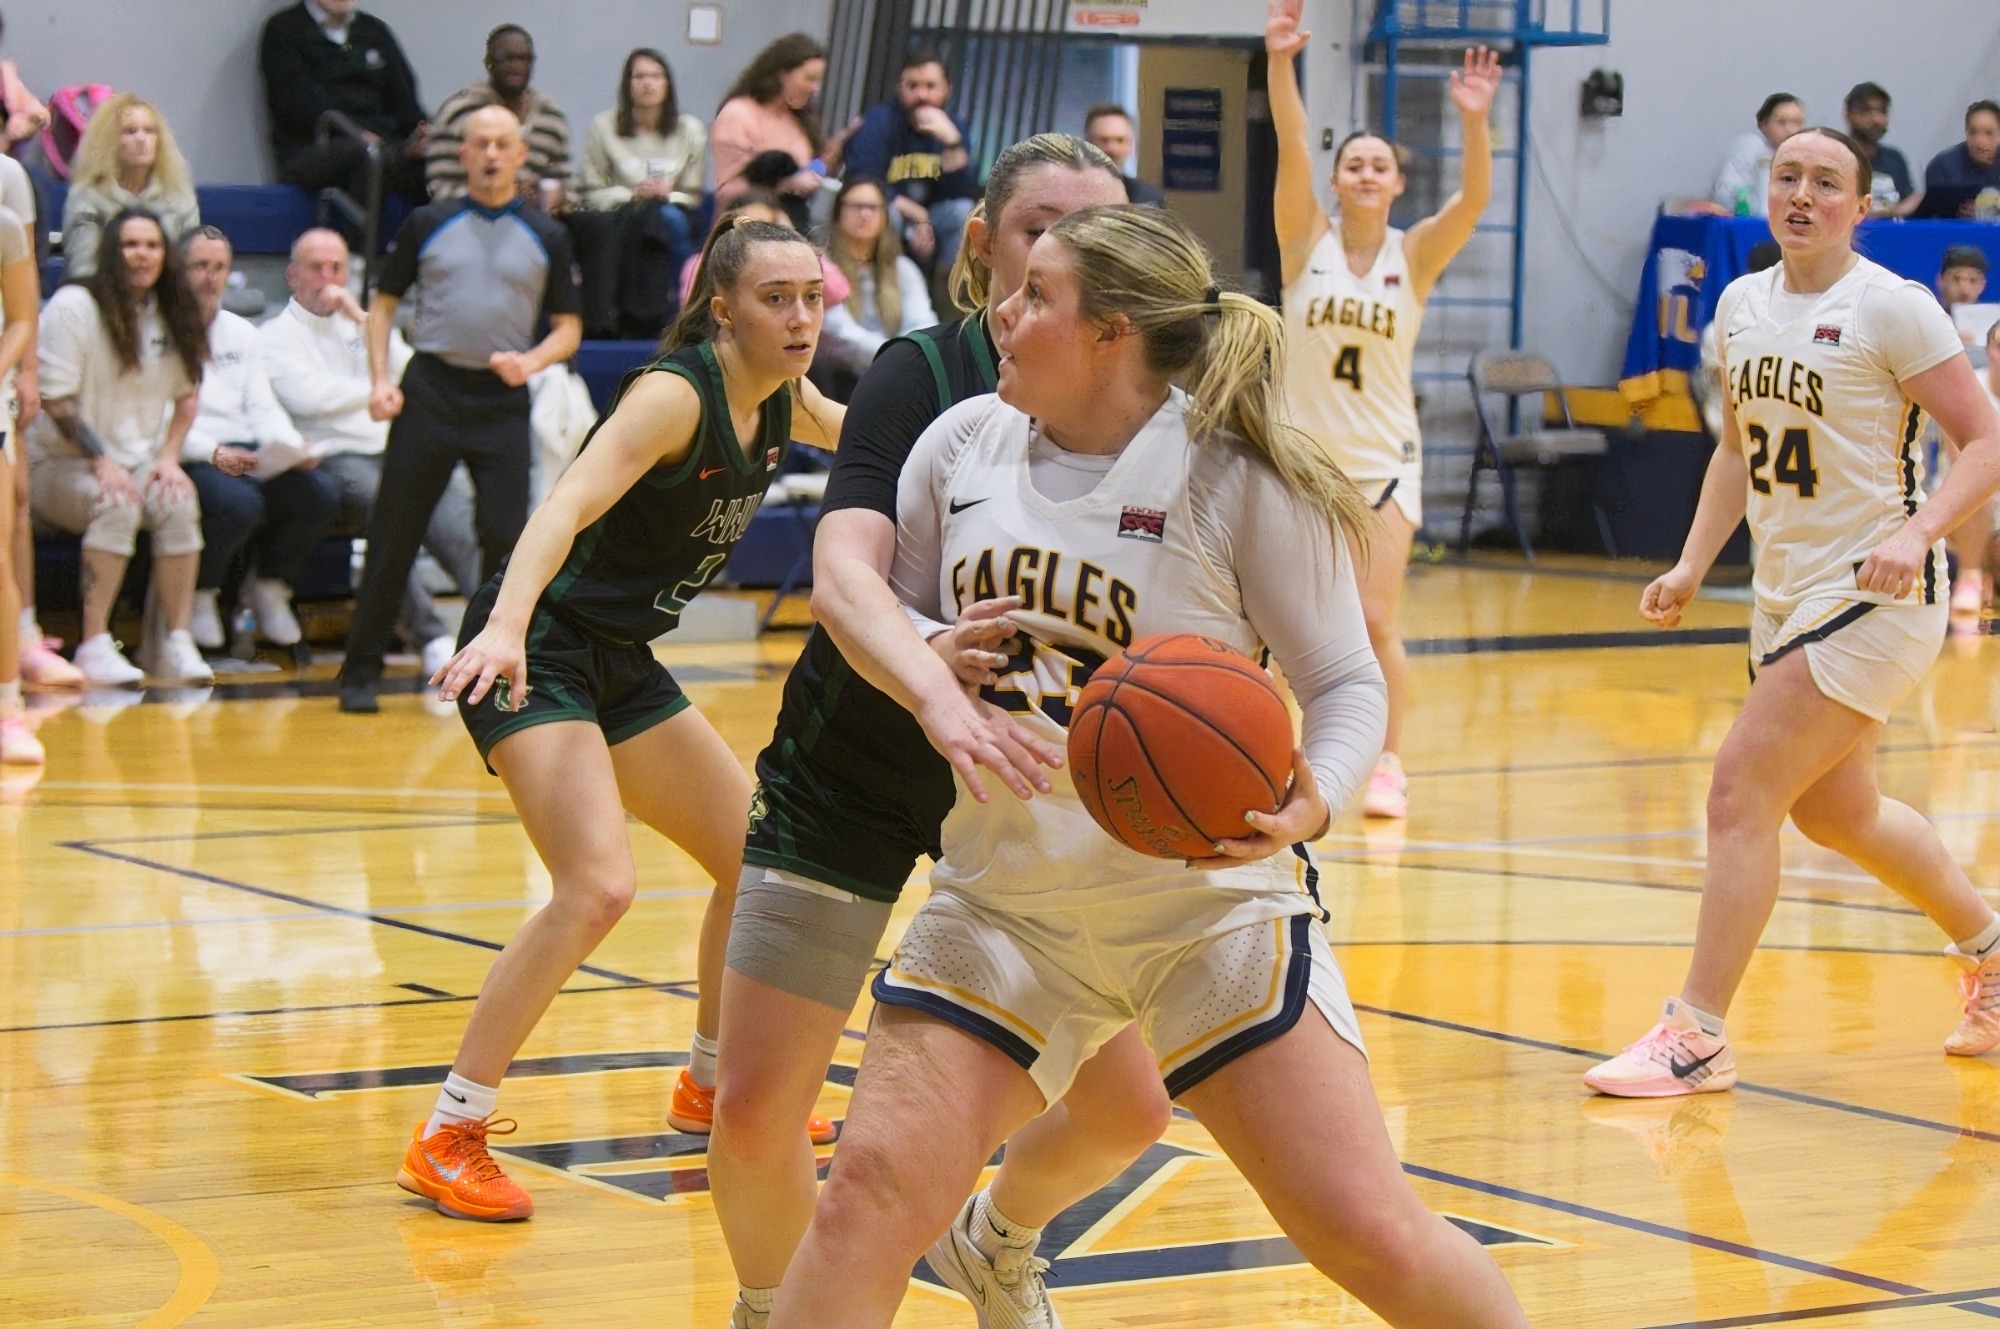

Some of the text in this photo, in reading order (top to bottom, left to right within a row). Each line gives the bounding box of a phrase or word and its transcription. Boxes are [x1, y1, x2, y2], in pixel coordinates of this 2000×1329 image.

[1306, 296, 1396, 340] EAGLES
[1332, 345, 1363, 392] 4
[1729, 356, 1824, 417] EAGLES
[1747, 422, 1821, 499] 24
[652, 552, 726, 616] 2
[952, 546, 1136, 651] EAGLES
